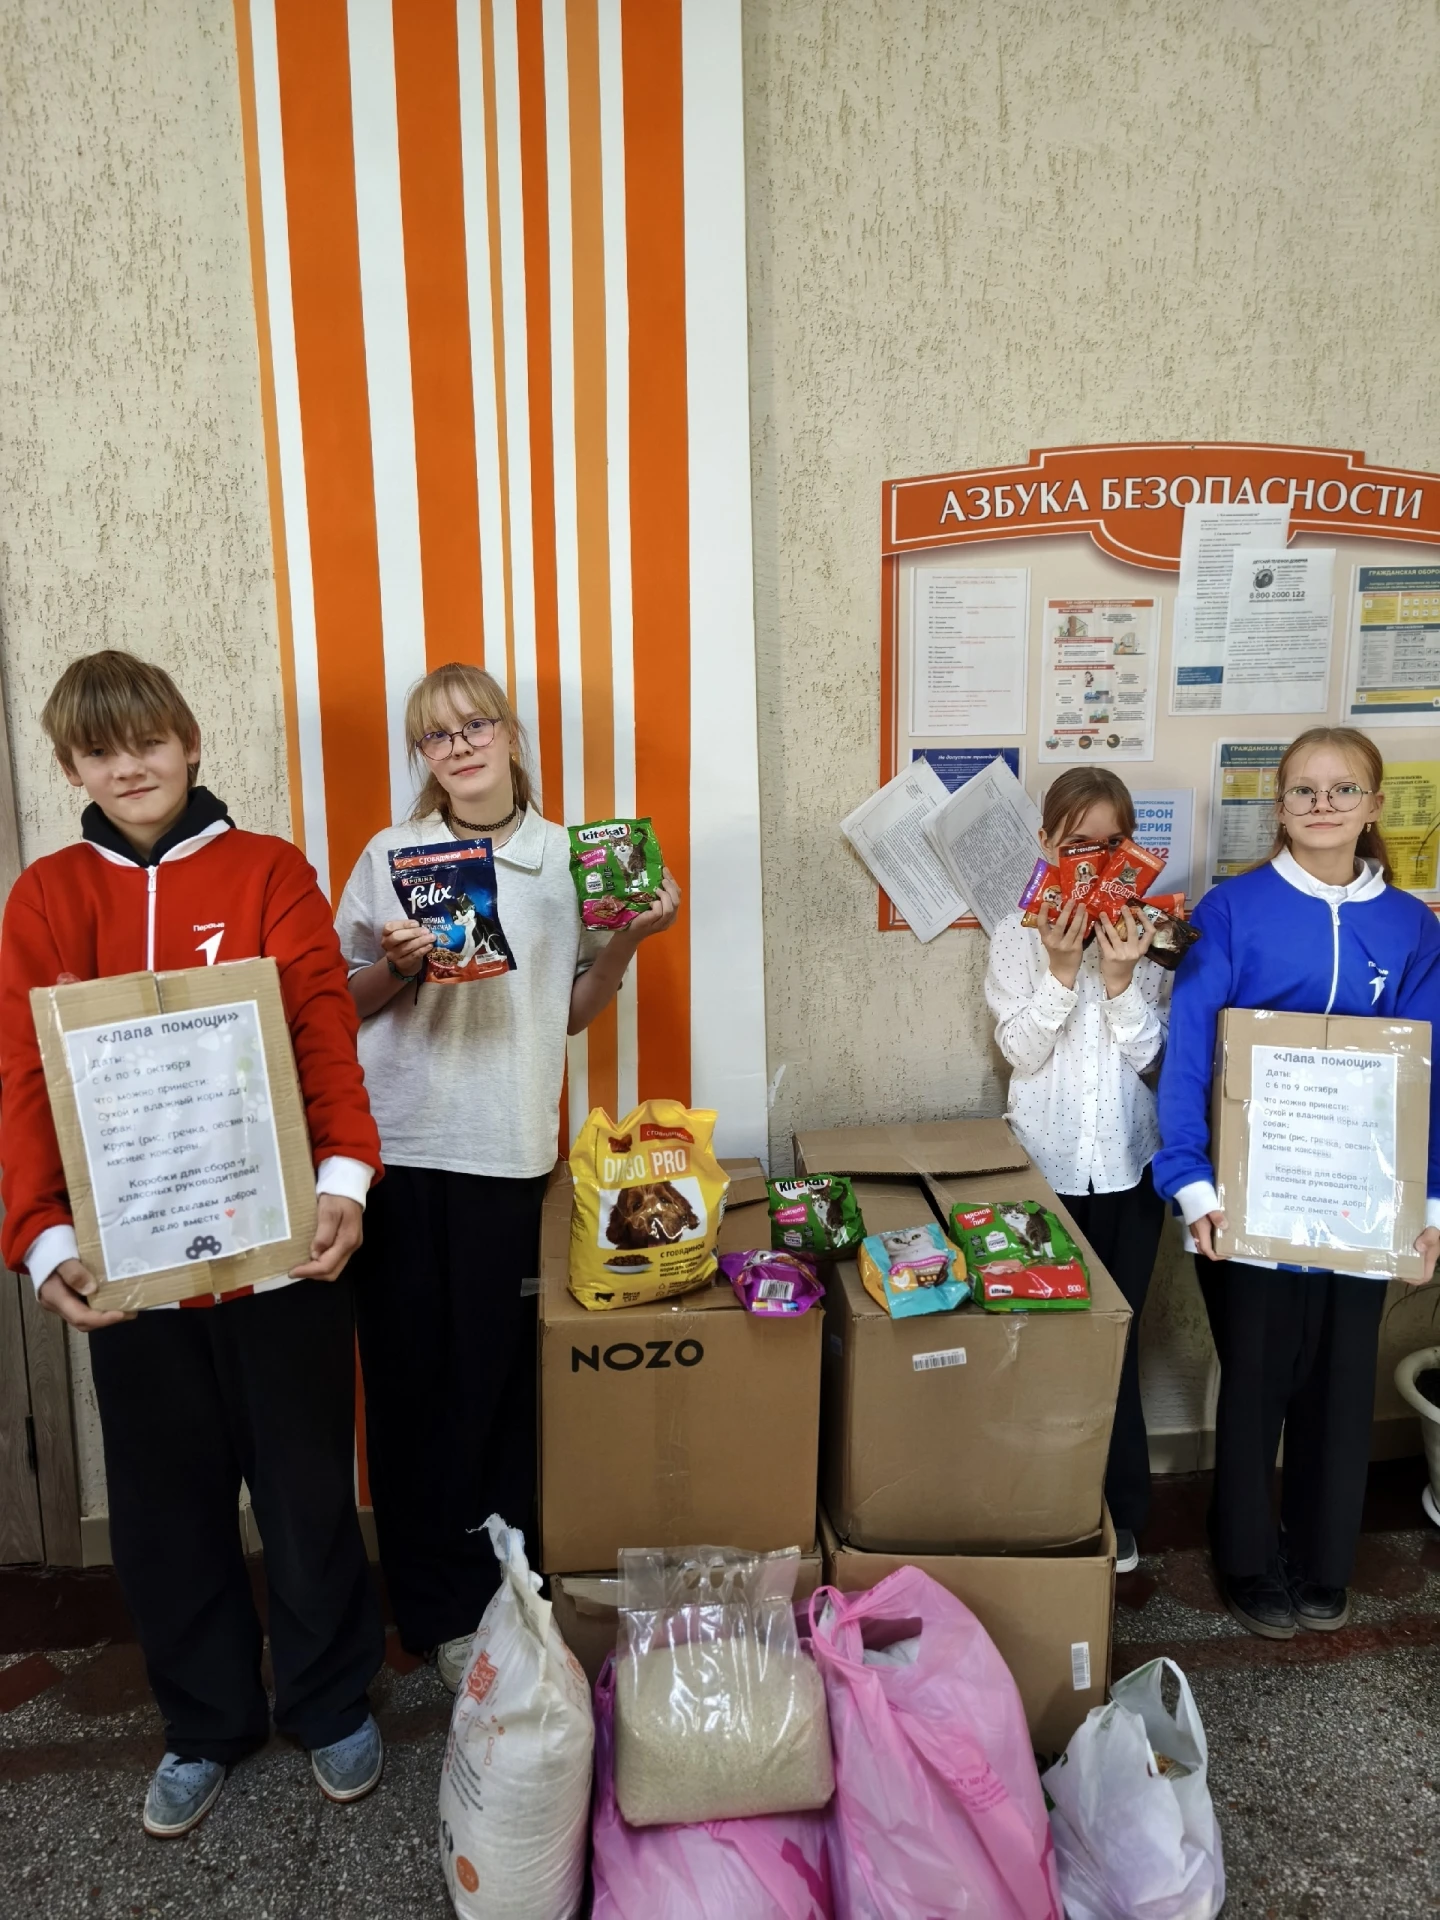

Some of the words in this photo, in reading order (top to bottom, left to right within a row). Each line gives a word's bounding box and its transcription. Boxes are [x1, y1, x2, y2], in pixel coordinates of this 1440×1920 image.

[939, 479, 1090, 524] АЗБУКА
[1101, 476, 1424, 520] БЕЗОПАСНОСТИ
[407, 882, 452, 915] felix
[96, 1025, 153, 1044] «Лапа
[161, 1012, 239, 1034] помощи»
[91, 1056, 126, 1069] Даты:
[1273, 1052, 1316, 1064] «Лапа
[1321, 1056, 1382, 1070] помощи»
[104, 1072, 112, 1083] 6
[116, 1071, 129, 1081] по
[133, 1067, 141, 1077] 9
[146, 1059, 192, 1075] октября
[1265, 1069, 1291, 1078] Даты:
[116, 1089, 154, 1102] можно
[157, 1078, 209, 1096] принести:
[1303, 1085, 1338, 1095] октября
[143, 1096, 193, 1113] влажный
[197, 1091, 224, 1103] корм
[1279, 1099, 1307, 1107] можно
[1309, 1100, 1350, 1111] принести:
[1296, 1111, 1334, 1122] влажный
[1361, 1120, 1379, 1129] для
[103, 1138, 136, 1152] Крупы
[167, 1125, 208, 1141] гречка,
[1262, 1131, 1286, 1140] Крупы
[1262, 1143, 1292, 1152] мясные
[106, 1153, 146, 1167] мясные
[603, 1154, 646, 1183] DINGO
[651, 1148, 687, 1176] PRO
[128, 1173, 178, 1190] Коробки
[180, 1168, 202, 1180] для
[204, 1160, 236, 1173] сбора
[1265, 1174, 1306, 1185] классных
[1275, 1164, 1312, 1176] Коробки
[1314, 1170, 1330, 1178] для
[1331, 1171, 1358, 1181] сбора
[118, 1186, 172, 1204] классных
[175, 1164, 260, 1193] руководителей!
[120, 1208, 167, 1227] Давайте
[170, 1198, 219, 1215] сделаем
[223, 1188, 258, 1204] доброе
[1284, 1204, 1305, 1213] дело
[1308, 1208, 1338, 1217] вместе
[1301, 1195, 1339, 1205] сделаем
[1341, 1199, 1367, 1208] добро
[150, 1222, 179, 1235] дело
[183, 1213, 220, 1228] вместе
[666, 1241, 705, 1258] говядиной
[572, 1339, 704, 1373] NOZO
